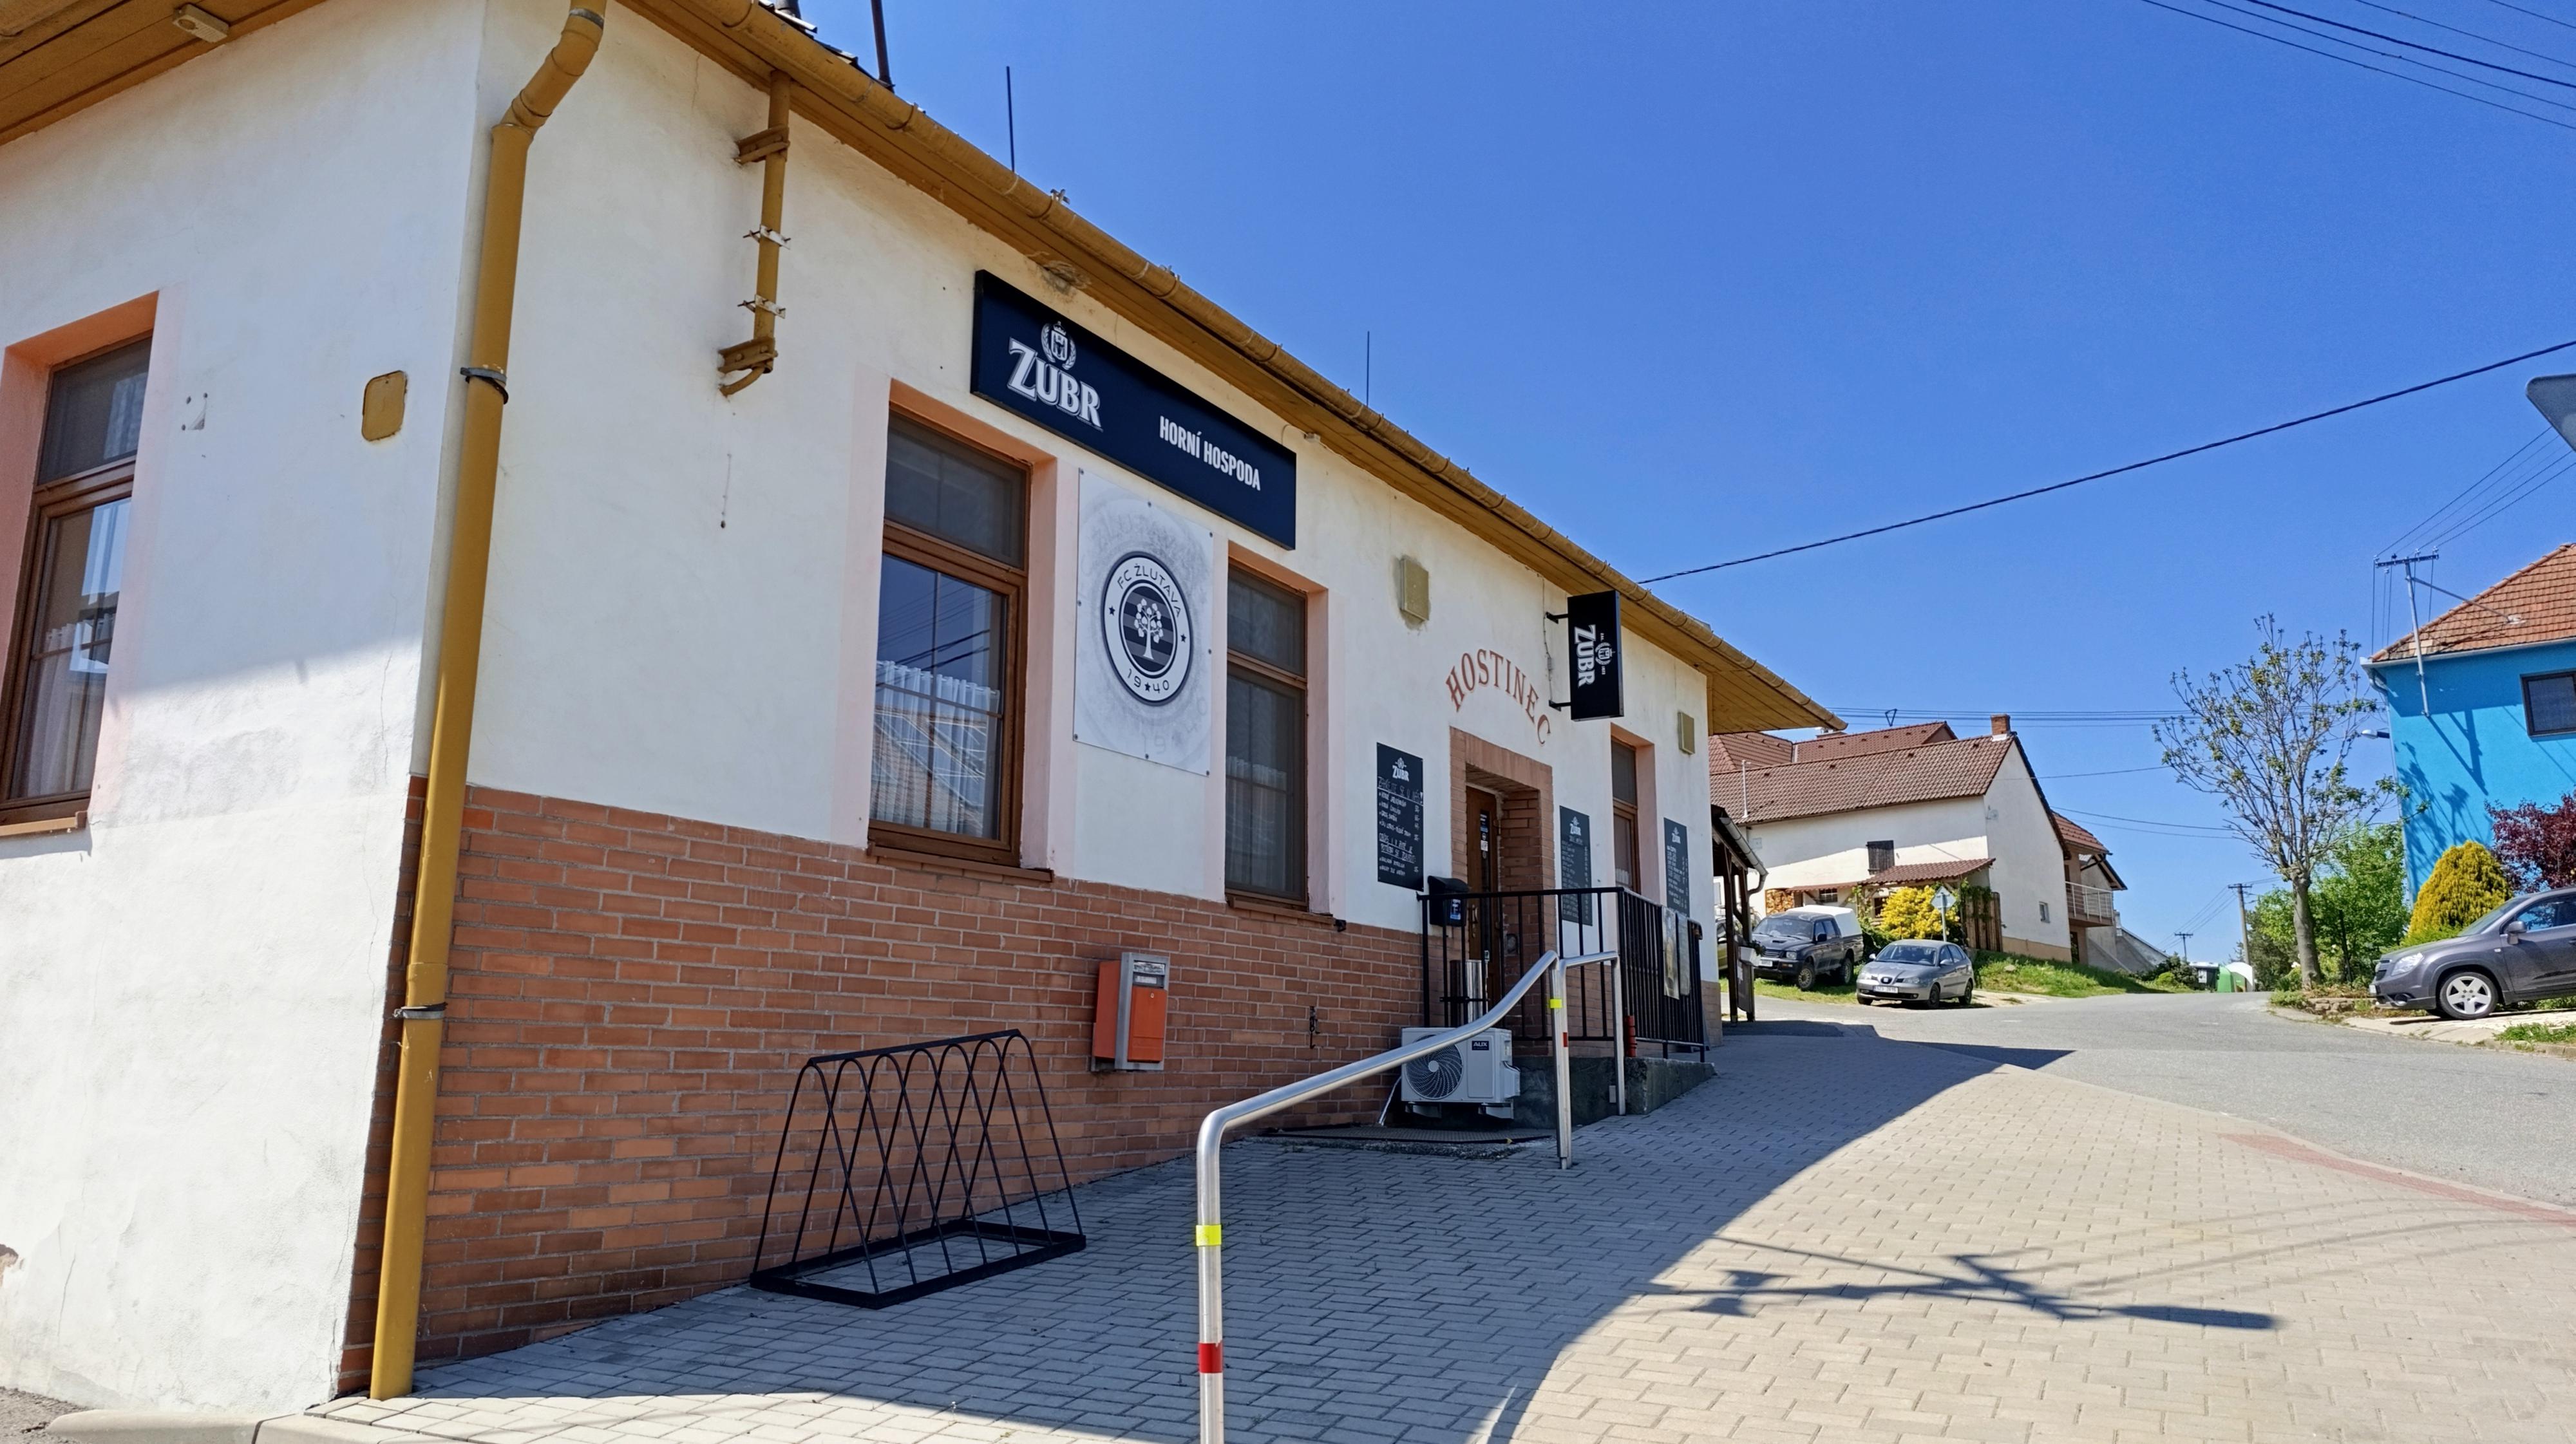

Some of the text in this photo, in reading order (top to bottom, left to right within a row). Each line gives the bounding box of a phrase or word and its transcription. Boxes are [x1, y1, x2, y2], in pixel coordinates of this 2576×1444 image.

[1007, 337, 1103, 432] ZUBR
[1159, 415, 1260, 491] HORNÍ HOSPODA
[1117, 569, 1132, 590] FC
[1574, 624, 1596, 688] ZUBR
[1446, 649, 1551, 744] HOSTINEC
[1392, 765, 1409, 782] ZUBR
